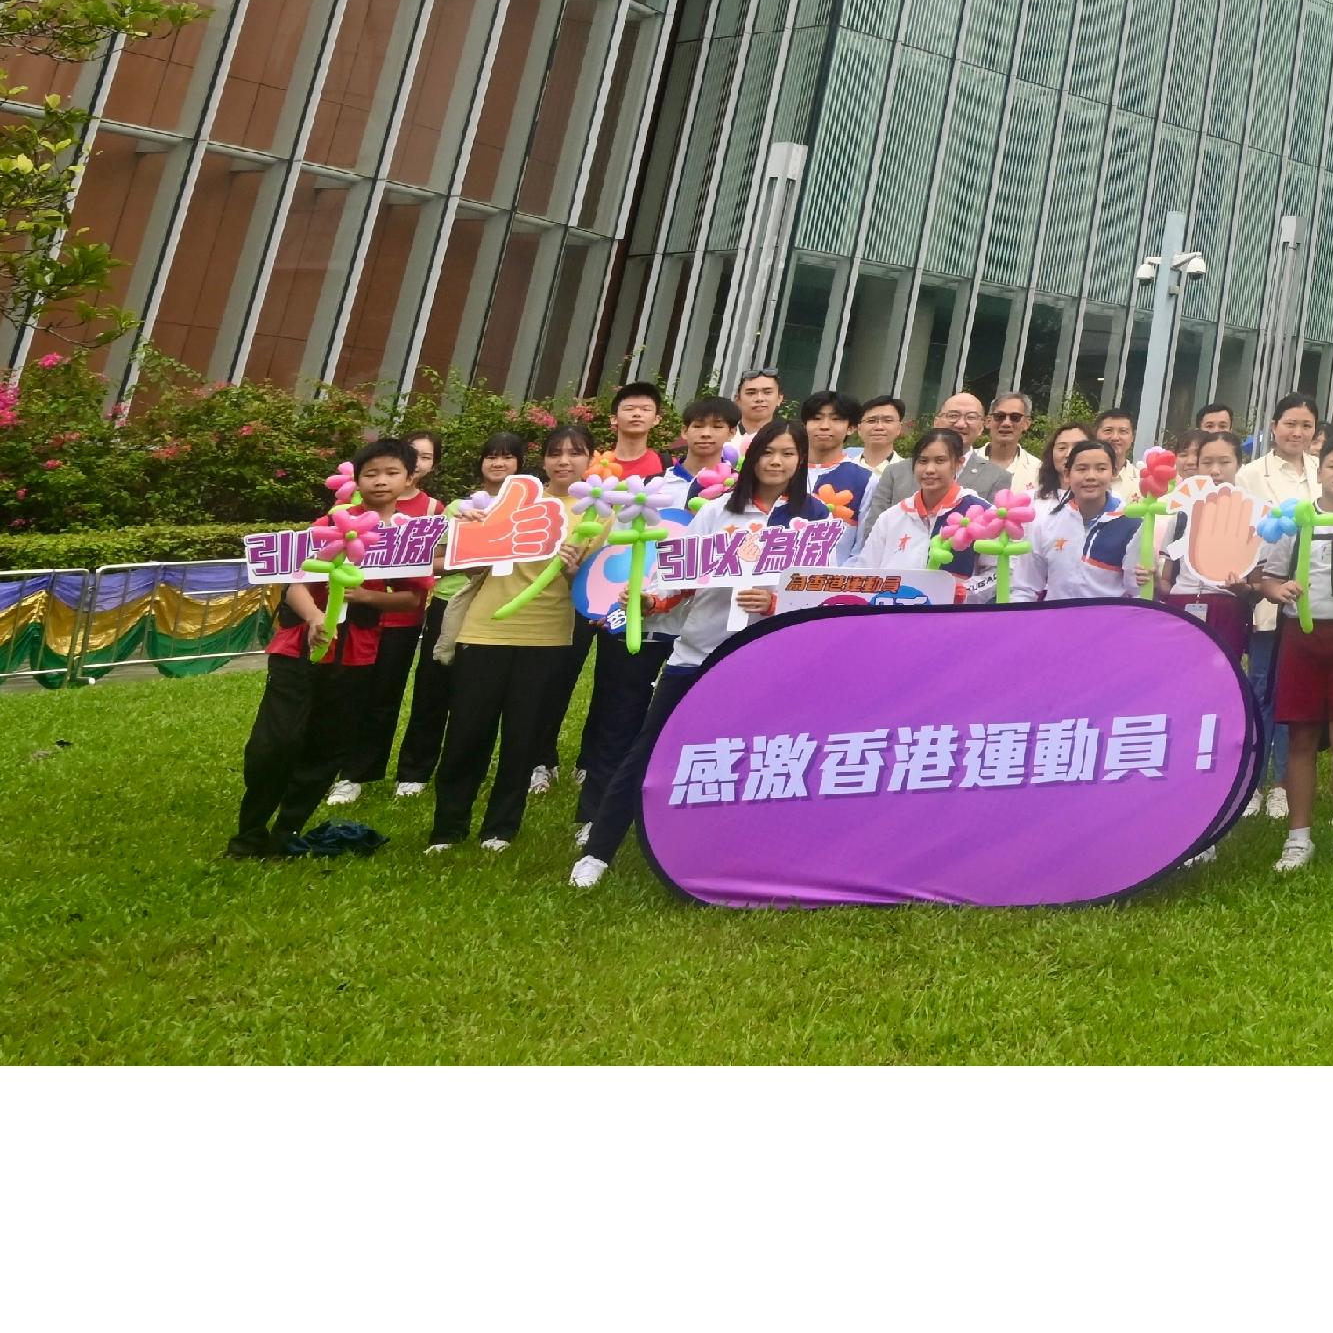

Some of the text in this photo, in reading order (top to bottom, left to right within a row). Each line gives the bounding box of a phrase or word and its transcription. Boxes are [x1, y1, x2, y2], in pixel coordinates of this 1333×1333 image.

[785, 572, 902, 594] 為香港運動員
